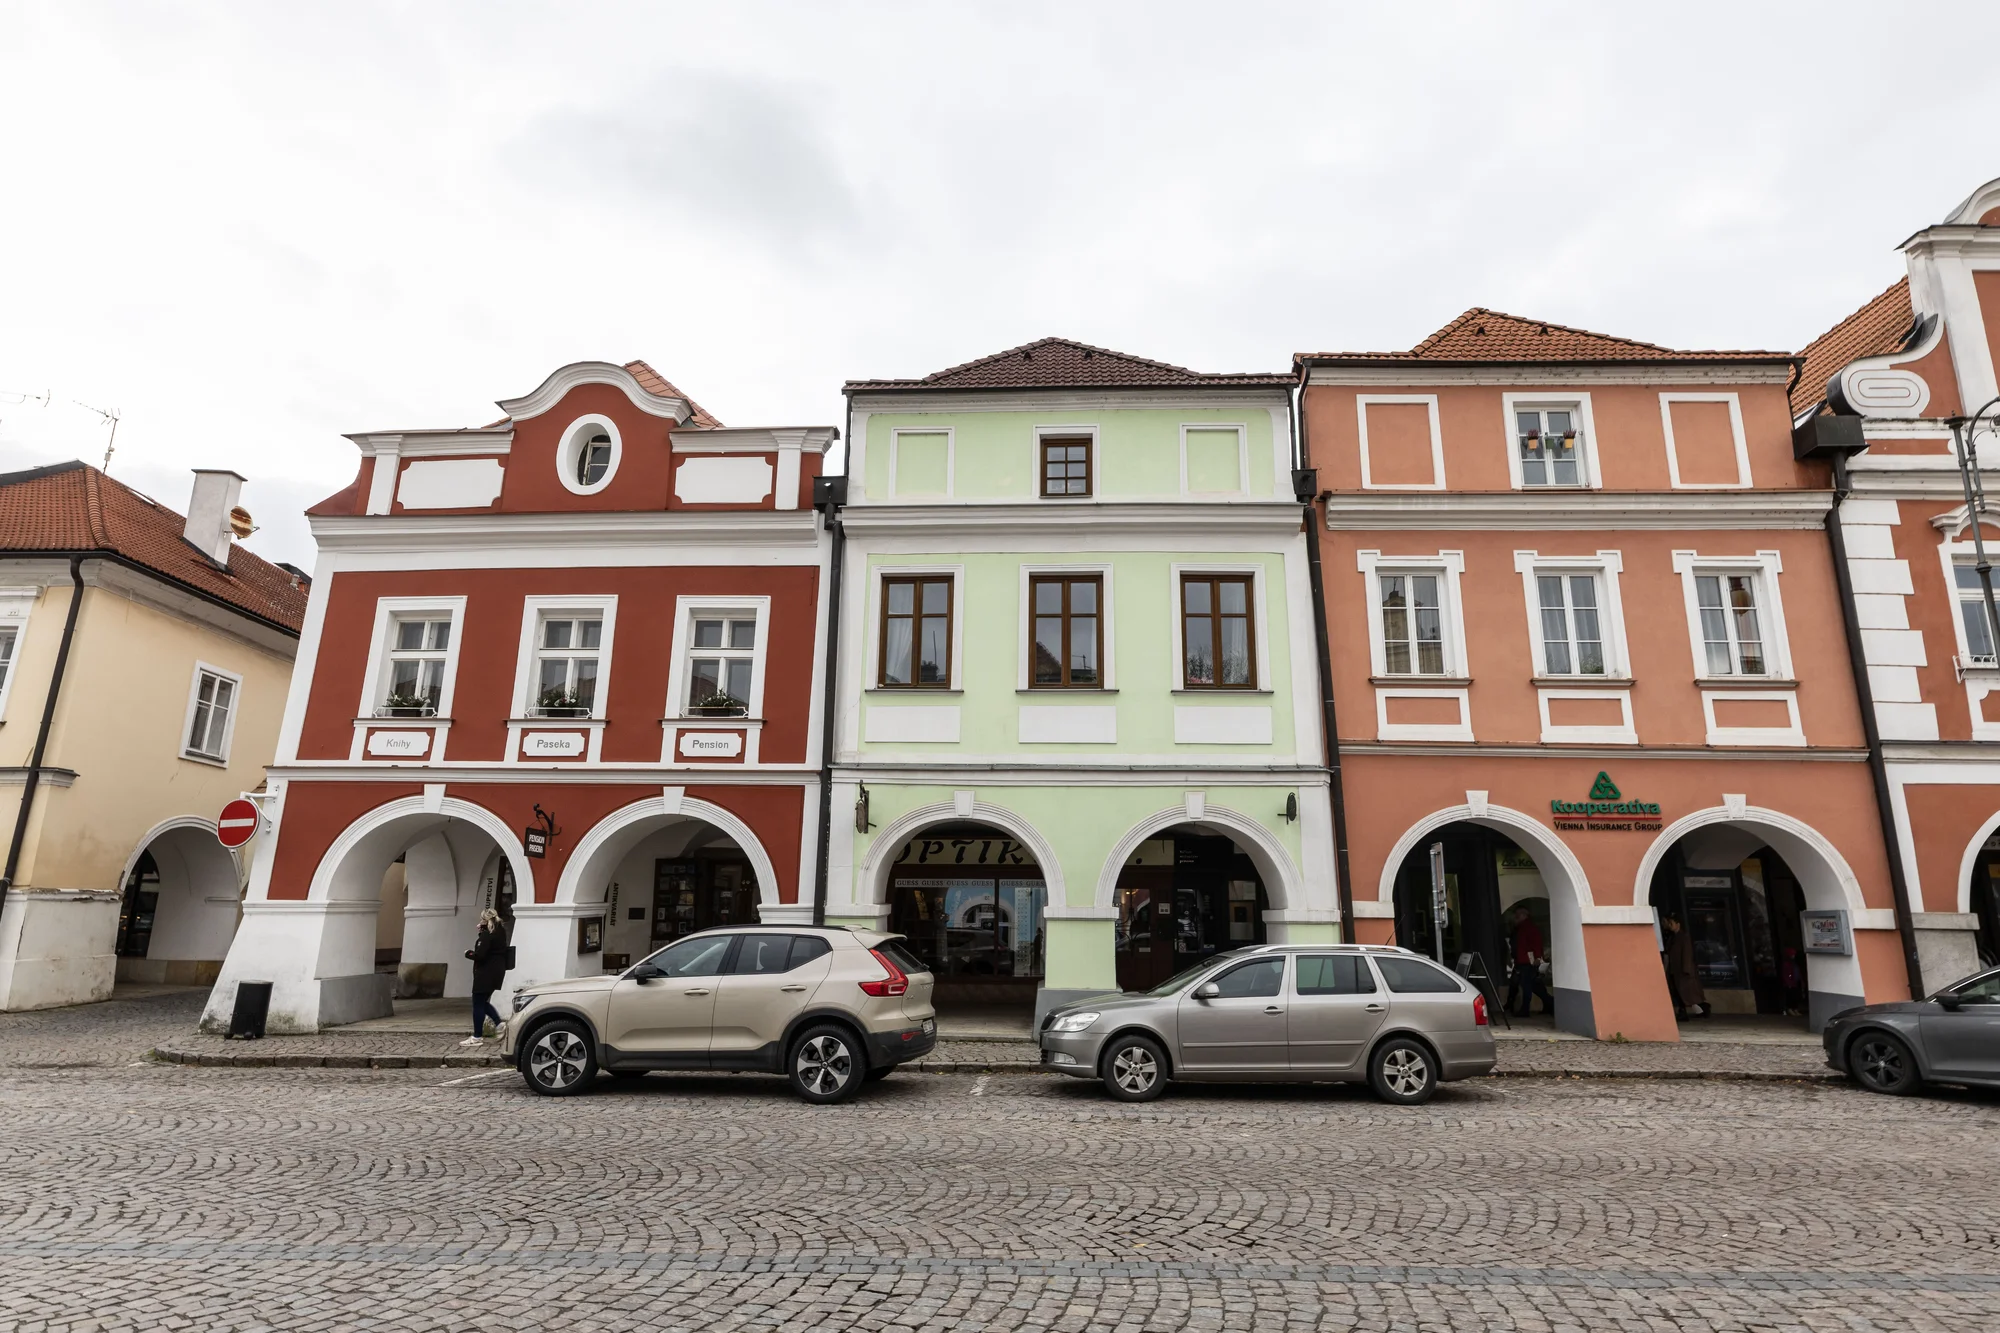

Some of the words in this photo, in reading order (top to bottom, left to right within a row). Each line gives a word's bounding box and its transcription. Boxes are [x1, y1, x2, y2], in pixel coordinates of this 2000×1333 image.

[386, 738, 411, 749] Knihy
[536, 739, 571, 749] Paseka
[692, 739, 729, 749] Pension
[1551, 799, 1661, 817] Kooperativa
[528, 834, 545, 844] PENSION
